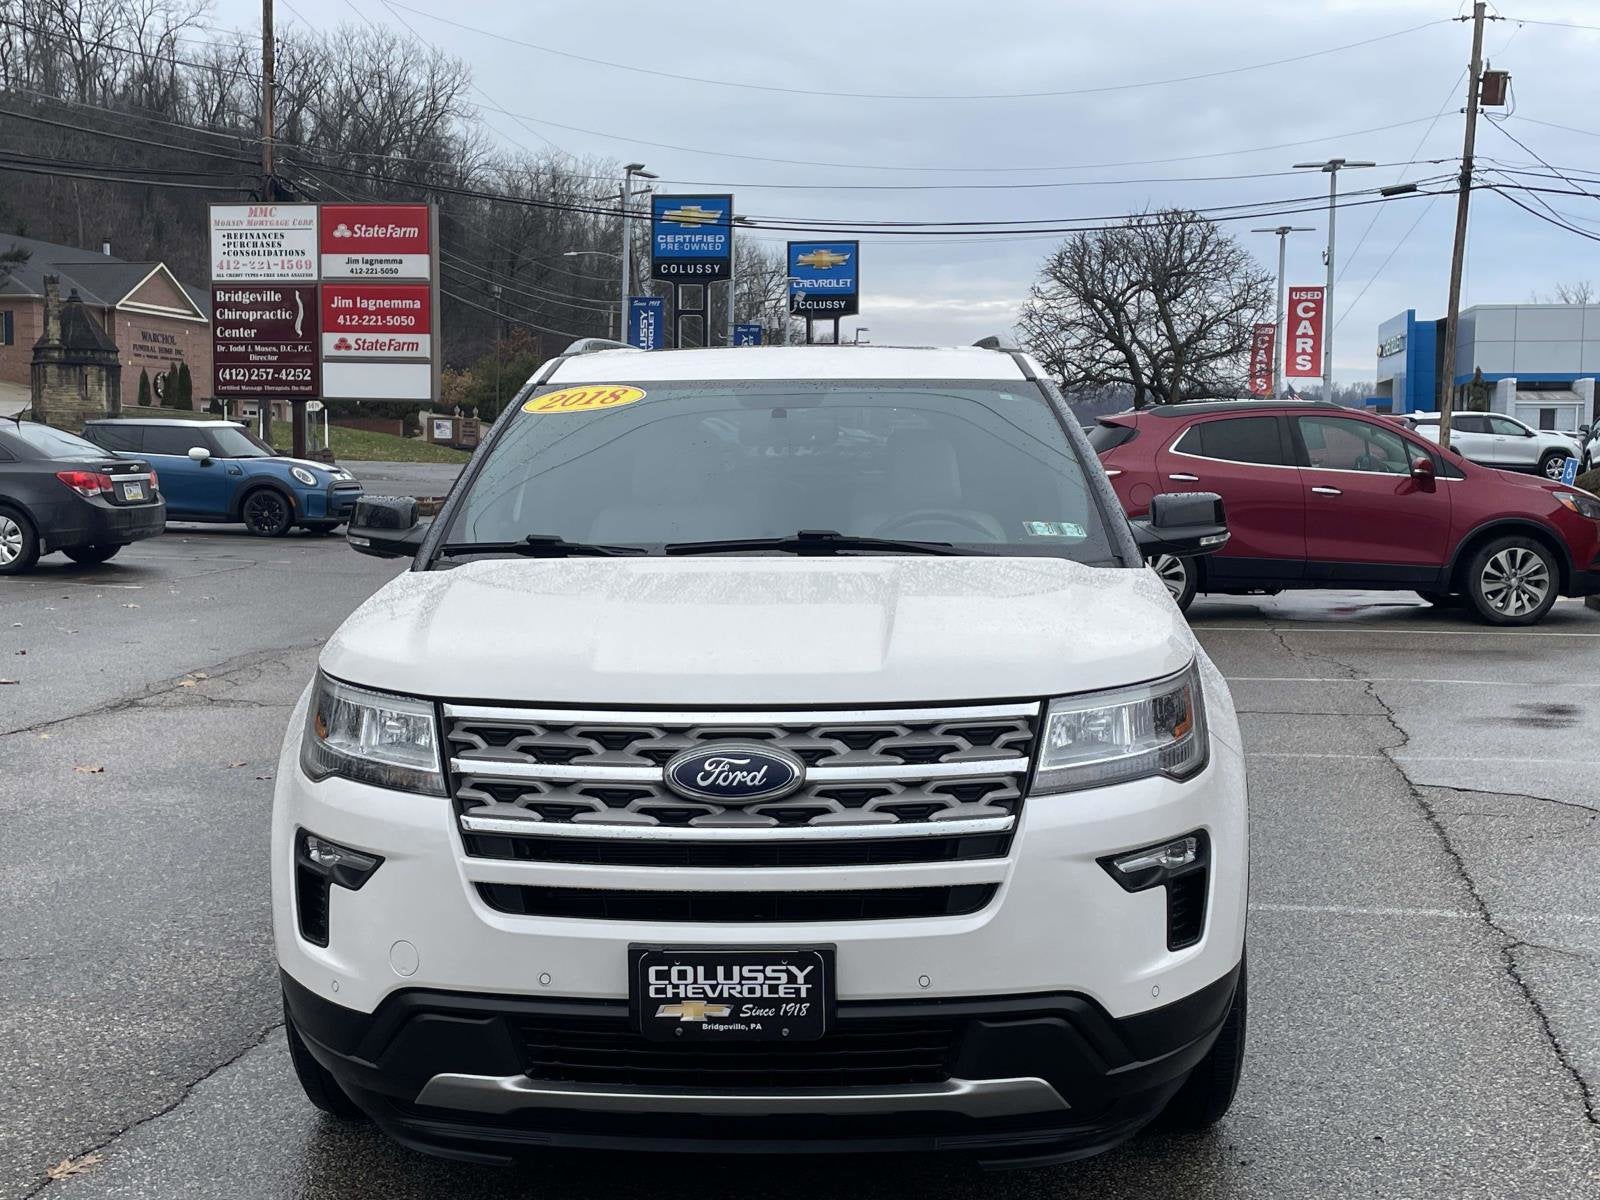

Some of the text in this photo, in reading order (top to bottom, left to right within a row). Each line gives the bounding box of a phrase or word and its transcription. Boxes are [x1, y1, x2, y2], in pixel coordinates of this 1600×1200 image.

[247, 207, 277, 217] MMC
[246, 219, 289, 227] MORTGAGE
[226, 232, 285, 240] REFINANCES
[657, 234, 725, 243] CERTIFIED
[226, 249, 306, 257] CONSOLIDATIONS
[660, 243, 722, 251] PRE-OWNED
[216, 259, 312, 270] 412-221-1569
[345, 257, 403, 267] Jim Iagnemma
[660, 264, 721, 274] COLUSSY
[216, 290, 282, 304] Bridgeville
[1292, 291, 1322, 300] USED
[331, 297, 421, 311] Jim Iagnemma
[799, 300, 847, 309] COLUSSY
[216, 308, 293, 322] Chiropractic
[337, 315, 415, 327] 412-221-5050
[141, 330, 177, 345] WARCHOL
[216, 326, 257, 338] Center
[1295, 301, 1316, 371] CARS
[218, 368, 311, 382] (412) 257-4252
[537, 388, 629, 411] 2018
[697, 757, 769, 787] Ford
[648, 964, 814, 985] COLUSSY
[649, 984, 813, 998] CHEVROLET
[739, 1003, 810, 1018] Since 1918
[702, 1023, 749, 1032] Bridgeville,
